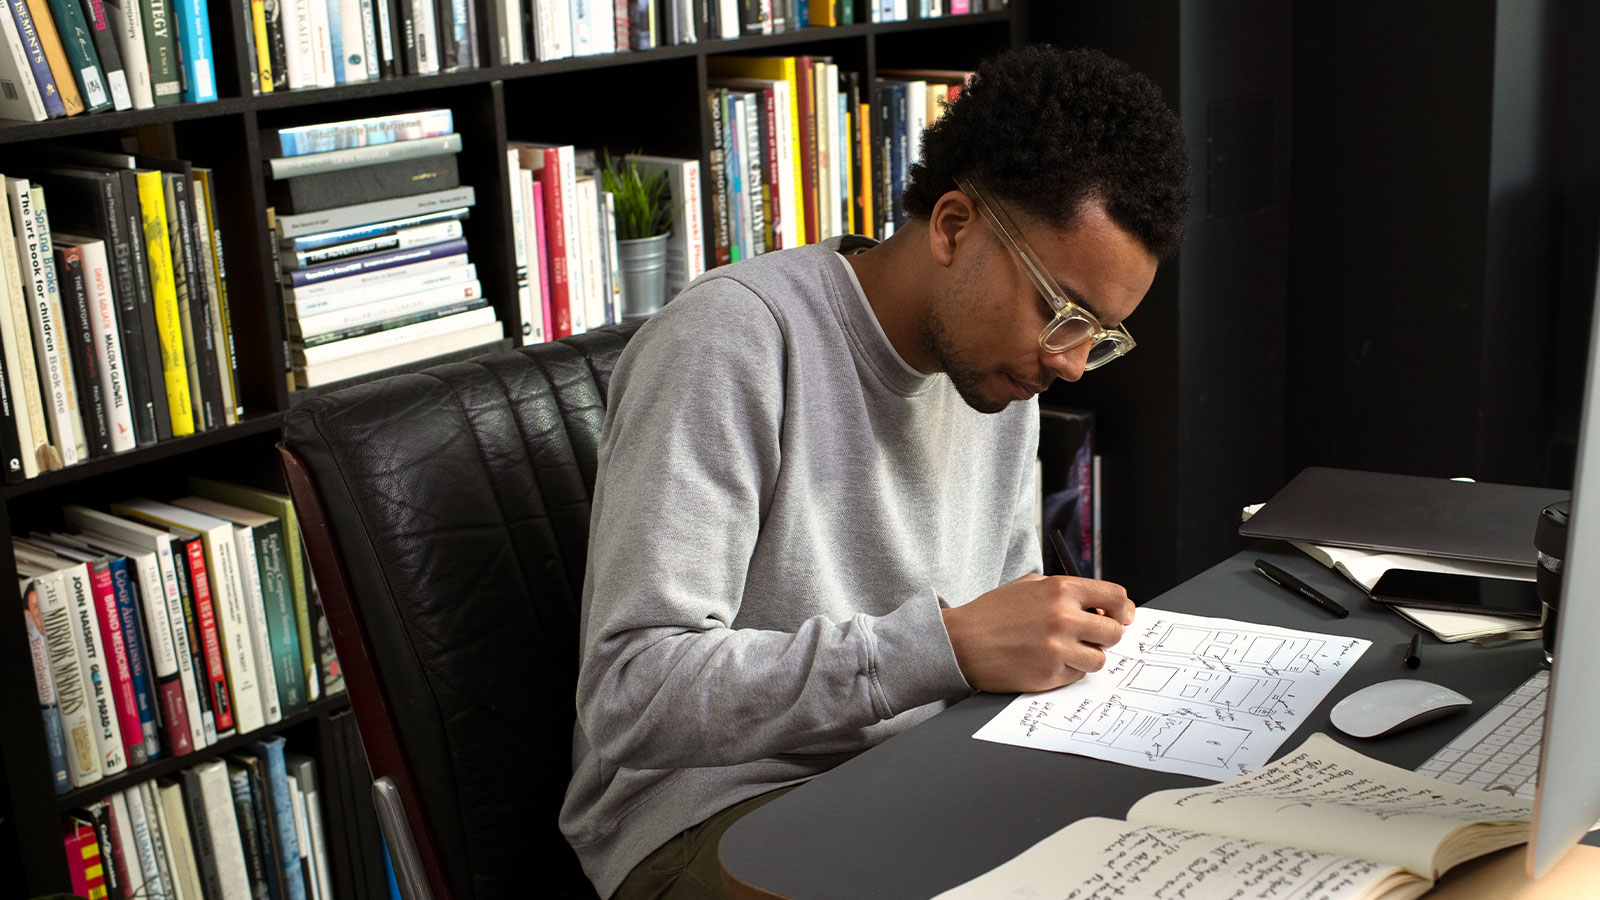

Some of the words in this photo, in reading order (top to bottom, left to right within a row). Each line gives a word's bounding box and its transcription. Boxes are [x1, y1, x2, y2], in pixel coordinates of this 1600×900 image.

[150, 0, 168, 40] TEGY
[159, 46, 170, 76] LYNCH
[713, 121, 721, 148] DAYS
[20, 191, 32, 216] The
[716, 164, 728, 248] PHOTOGRAPHS
[25, 219, 36, 240] art
[29, 243, 43, 277] book
[33, 208, 52, 253] Spring
[43, 257, 59, 294] Broke
[35, 279, 47, 299] for
[73, 275, 83, 292] THE
[39, 301, 56, 353] children
[76, 292, 90, 331] ANATOMY
[83, 332, 92, 344] OF
[103, 333, 118, 371] MALCOLM
[49, 355, 63, 389] Book
[110, 371, 125, 409] GLADWELL
[55, 391, 66, 414] one
[92, 385, 101, 403] PAUL
[268, 533, 282, 572] Exploring
[72, 575, 86, 608] JOHN
[79, 609, 97, 660] NAISBITT
[103, 594, 120, 631] BRAND
[42, 606, 76, 663] MIRROR
[111, 631, 130, 682] MEDICINE
[53, 661, 87, 717] MAKERS
